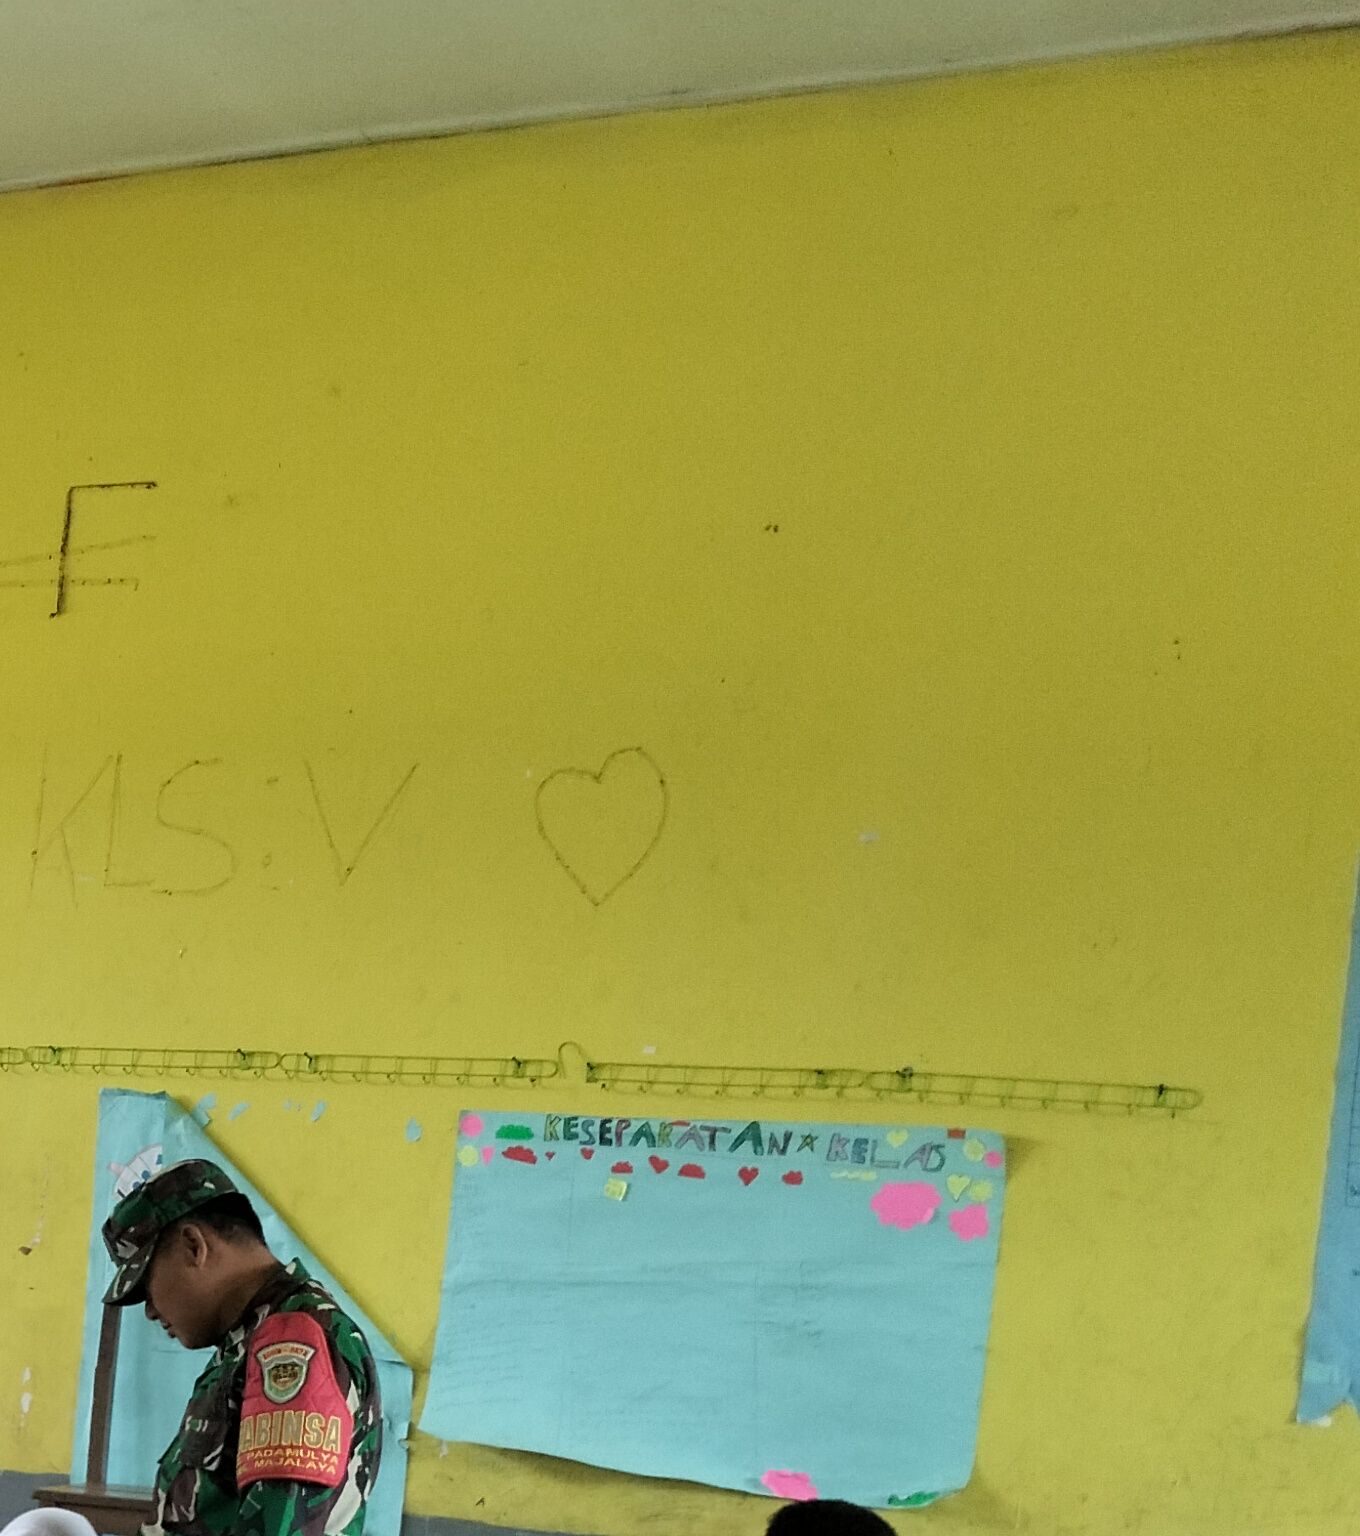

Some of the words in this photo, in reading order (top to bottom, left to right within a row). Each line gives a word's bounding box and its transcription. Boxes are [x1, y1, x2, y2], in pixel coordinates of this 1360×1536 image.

[543, 1113, 793, 1157] KESEPAKATAN
[827, 1132, 946, 1173] KELAS
[239, 1409, 342, 1454] ABINSA
[246, 1448, 339, 1466] PADAMULYA
[254, 1457, 336, 1476] MAJALAYA
